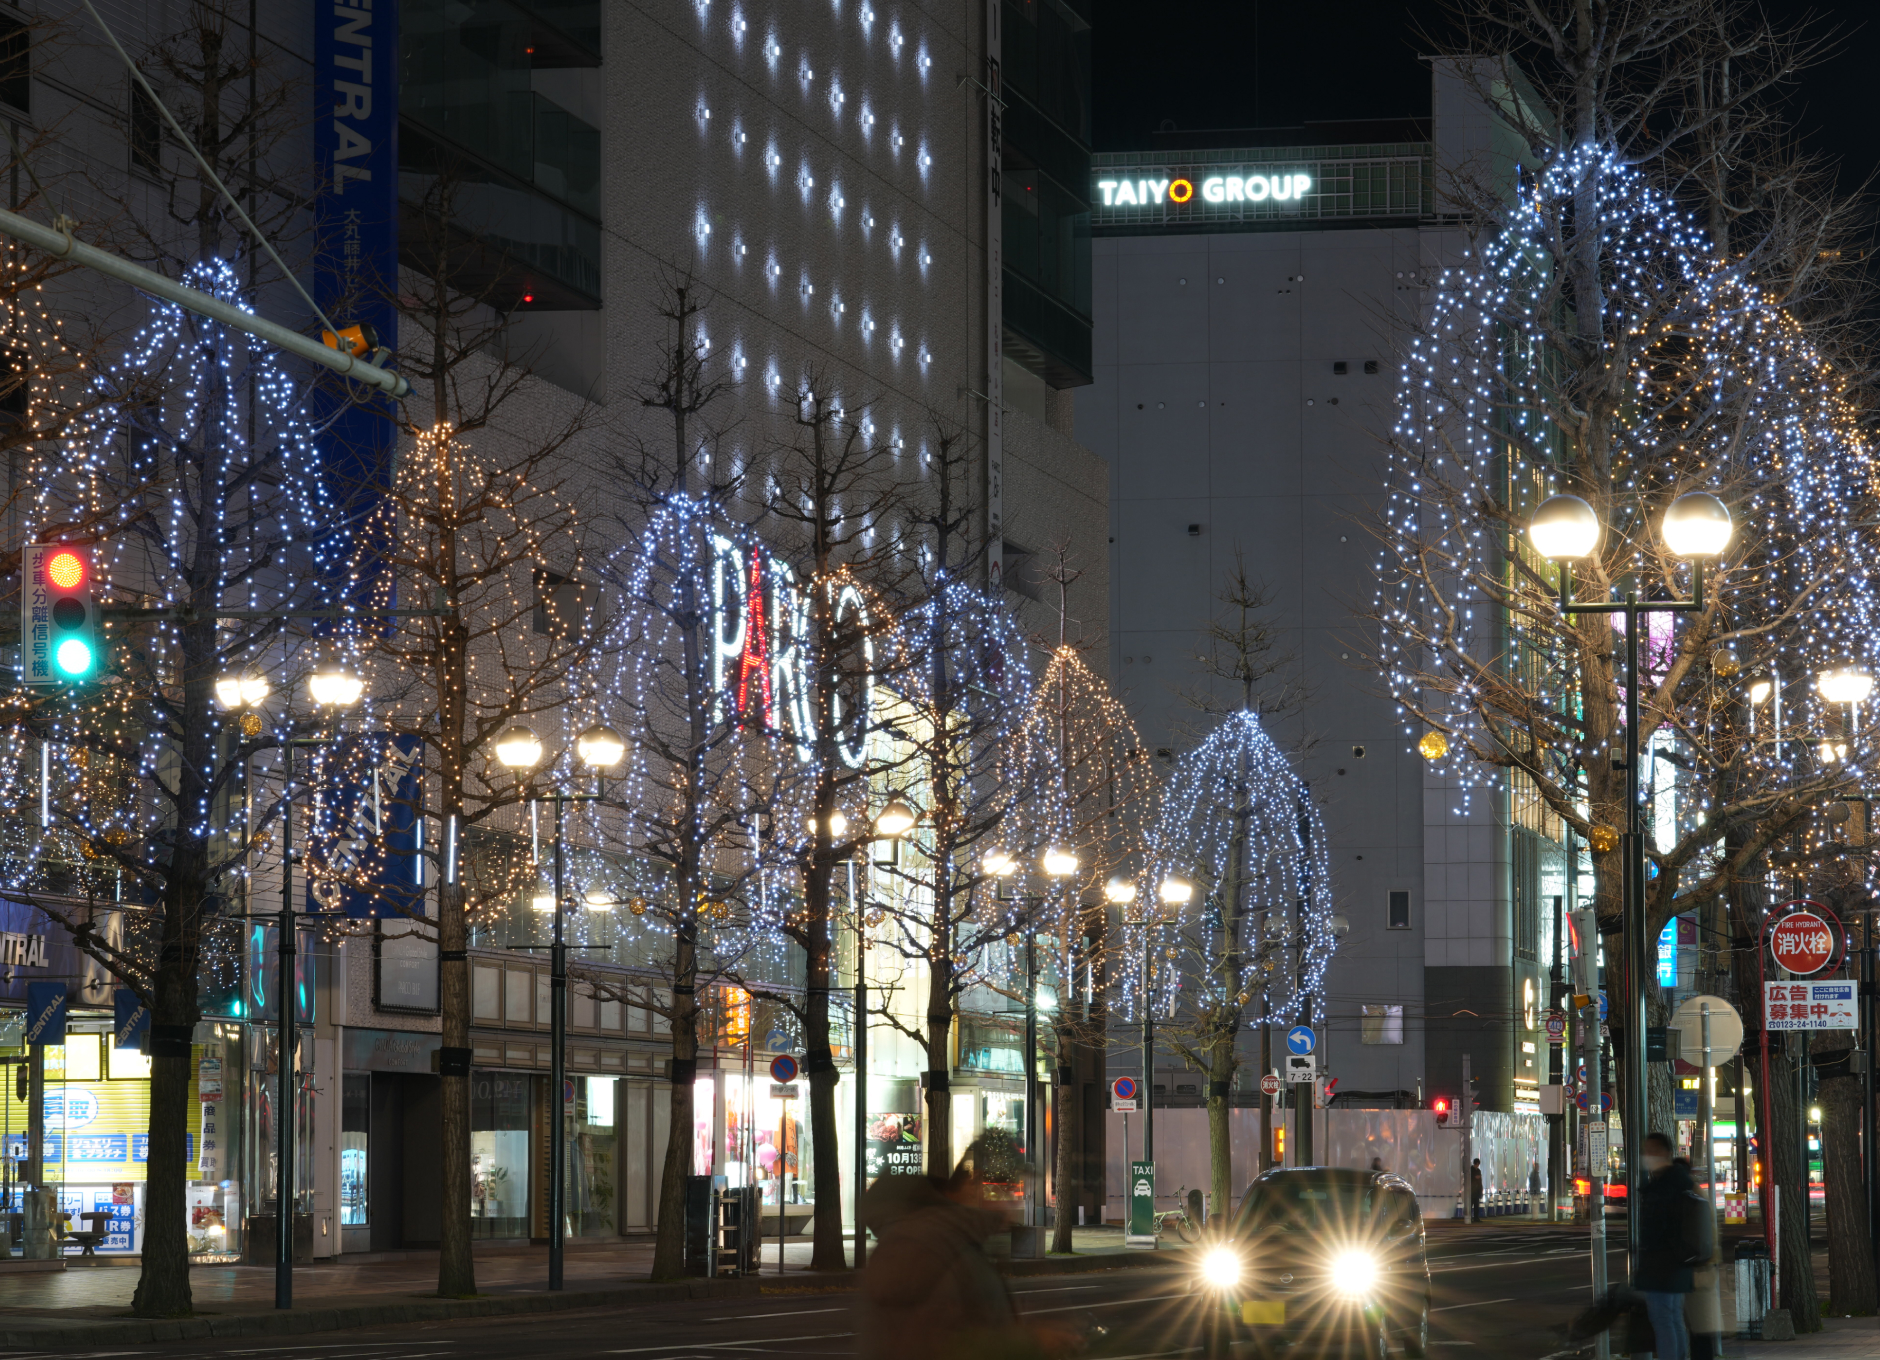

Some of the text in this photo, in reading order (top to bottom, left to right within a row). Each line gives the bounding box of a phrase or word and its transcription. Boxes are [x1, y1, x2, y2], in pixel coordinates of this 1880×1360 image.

[1098, 173, 1312, 206] TAIYO GROUP
[31, 551, 49, 677] 歩車分離信号機
[711, 533, 875, 769] PARCO
[311, 742, 420, 907] CENTRAL
[1795, 920, 1822, 928] HYDRANT
[1777, 931, 1828, 956] 消火栓
[1768, 985, 1808, 1002] 広告
[28, 993, 65, 1042] CENTRAL
[1768, 1003, 1829, 1021] 募集中
[115, 1005, 147, 1047] CENTRA
[1549, 1020, 1562, 1031] 40
[1776, 1020, 1827, 1028] 0123-24-1140
[1262, 1080, 1280, 1090] 消火栓
[202, 1106, 216, 1151] 商品券
[890, 1165, 905, 1176] 8F
[1132, 1165, 1154, 1175] TAXI
